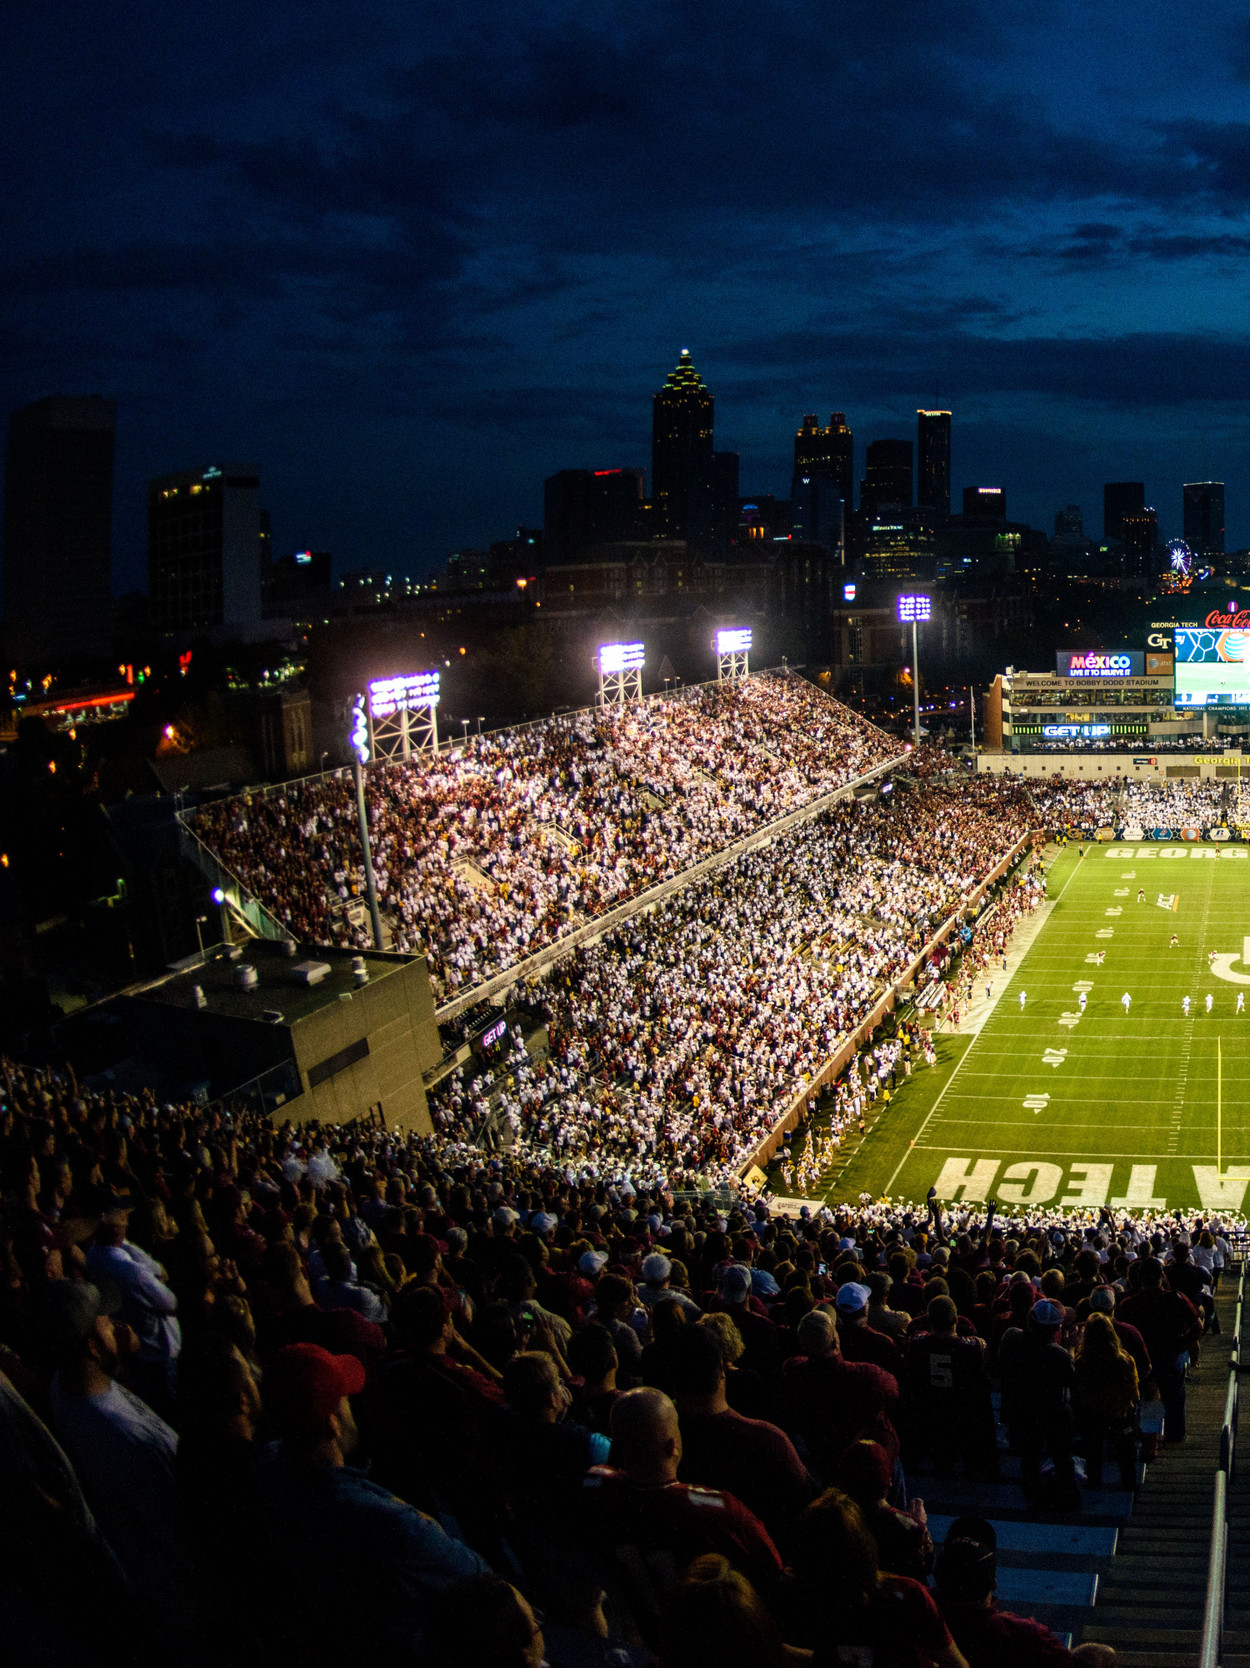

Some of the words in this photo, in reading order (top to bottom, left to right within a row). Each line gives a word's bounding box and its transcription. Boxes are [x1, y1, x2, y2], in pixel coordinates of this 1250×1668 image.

[1148, 633, 1172, 649] GT
[1044, 726, 1080, 736] GET
[1083, 726, 1109, 736] UP
[1194, 756, 1241, 765] Georgia
[1072, 980, 1094, 991] 40
[1058, 1012, 1082, 1024] 30
[482, 1028, 497, 1046] GET
[496, 1020, 506, 1036] UP
[1042, 1048, 1068, 1063] 20
[1022, 1093, 1050, 1108] 10
[928, 1157, 1166, 1209] TECH
[930, 1354, 952, 1387] 5
